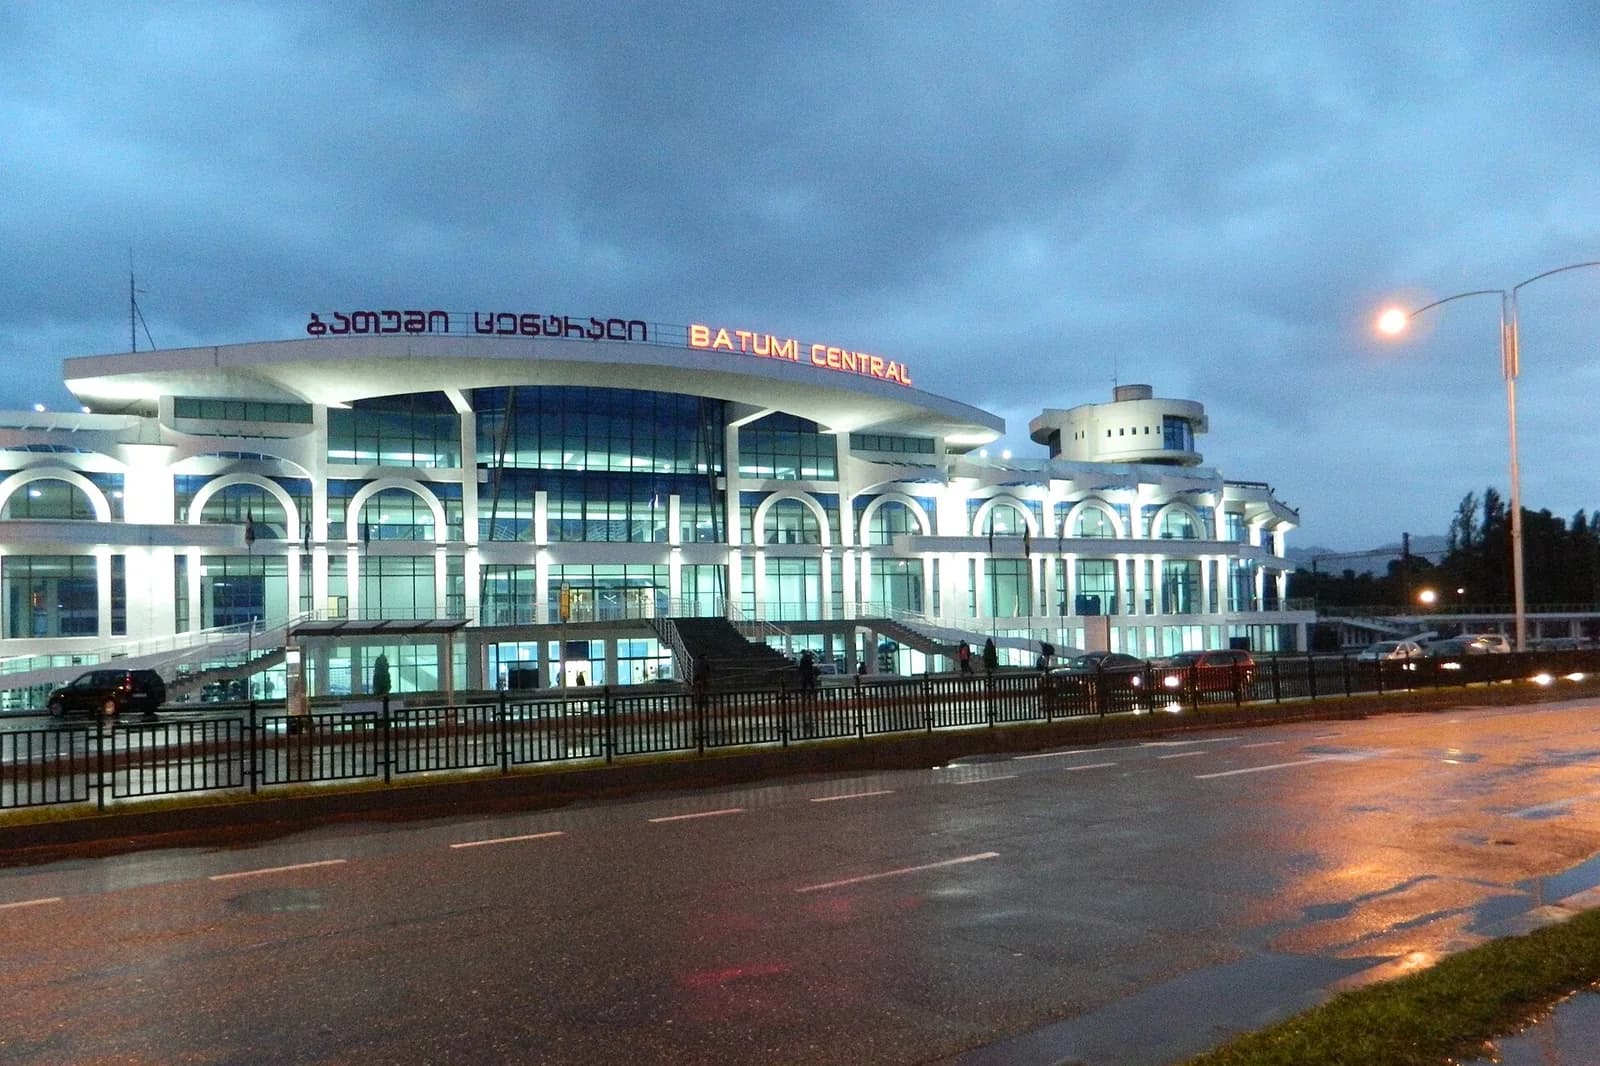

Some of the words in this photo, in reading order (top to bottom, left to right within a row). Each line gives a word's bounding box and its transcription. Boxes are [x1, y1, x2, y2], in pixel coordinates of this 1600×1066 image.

[306, 310, 449, 335] ბათუმი
[690, 324, 799, 361] BATUMI
[811, 344, 912, 385] CENTRAL
